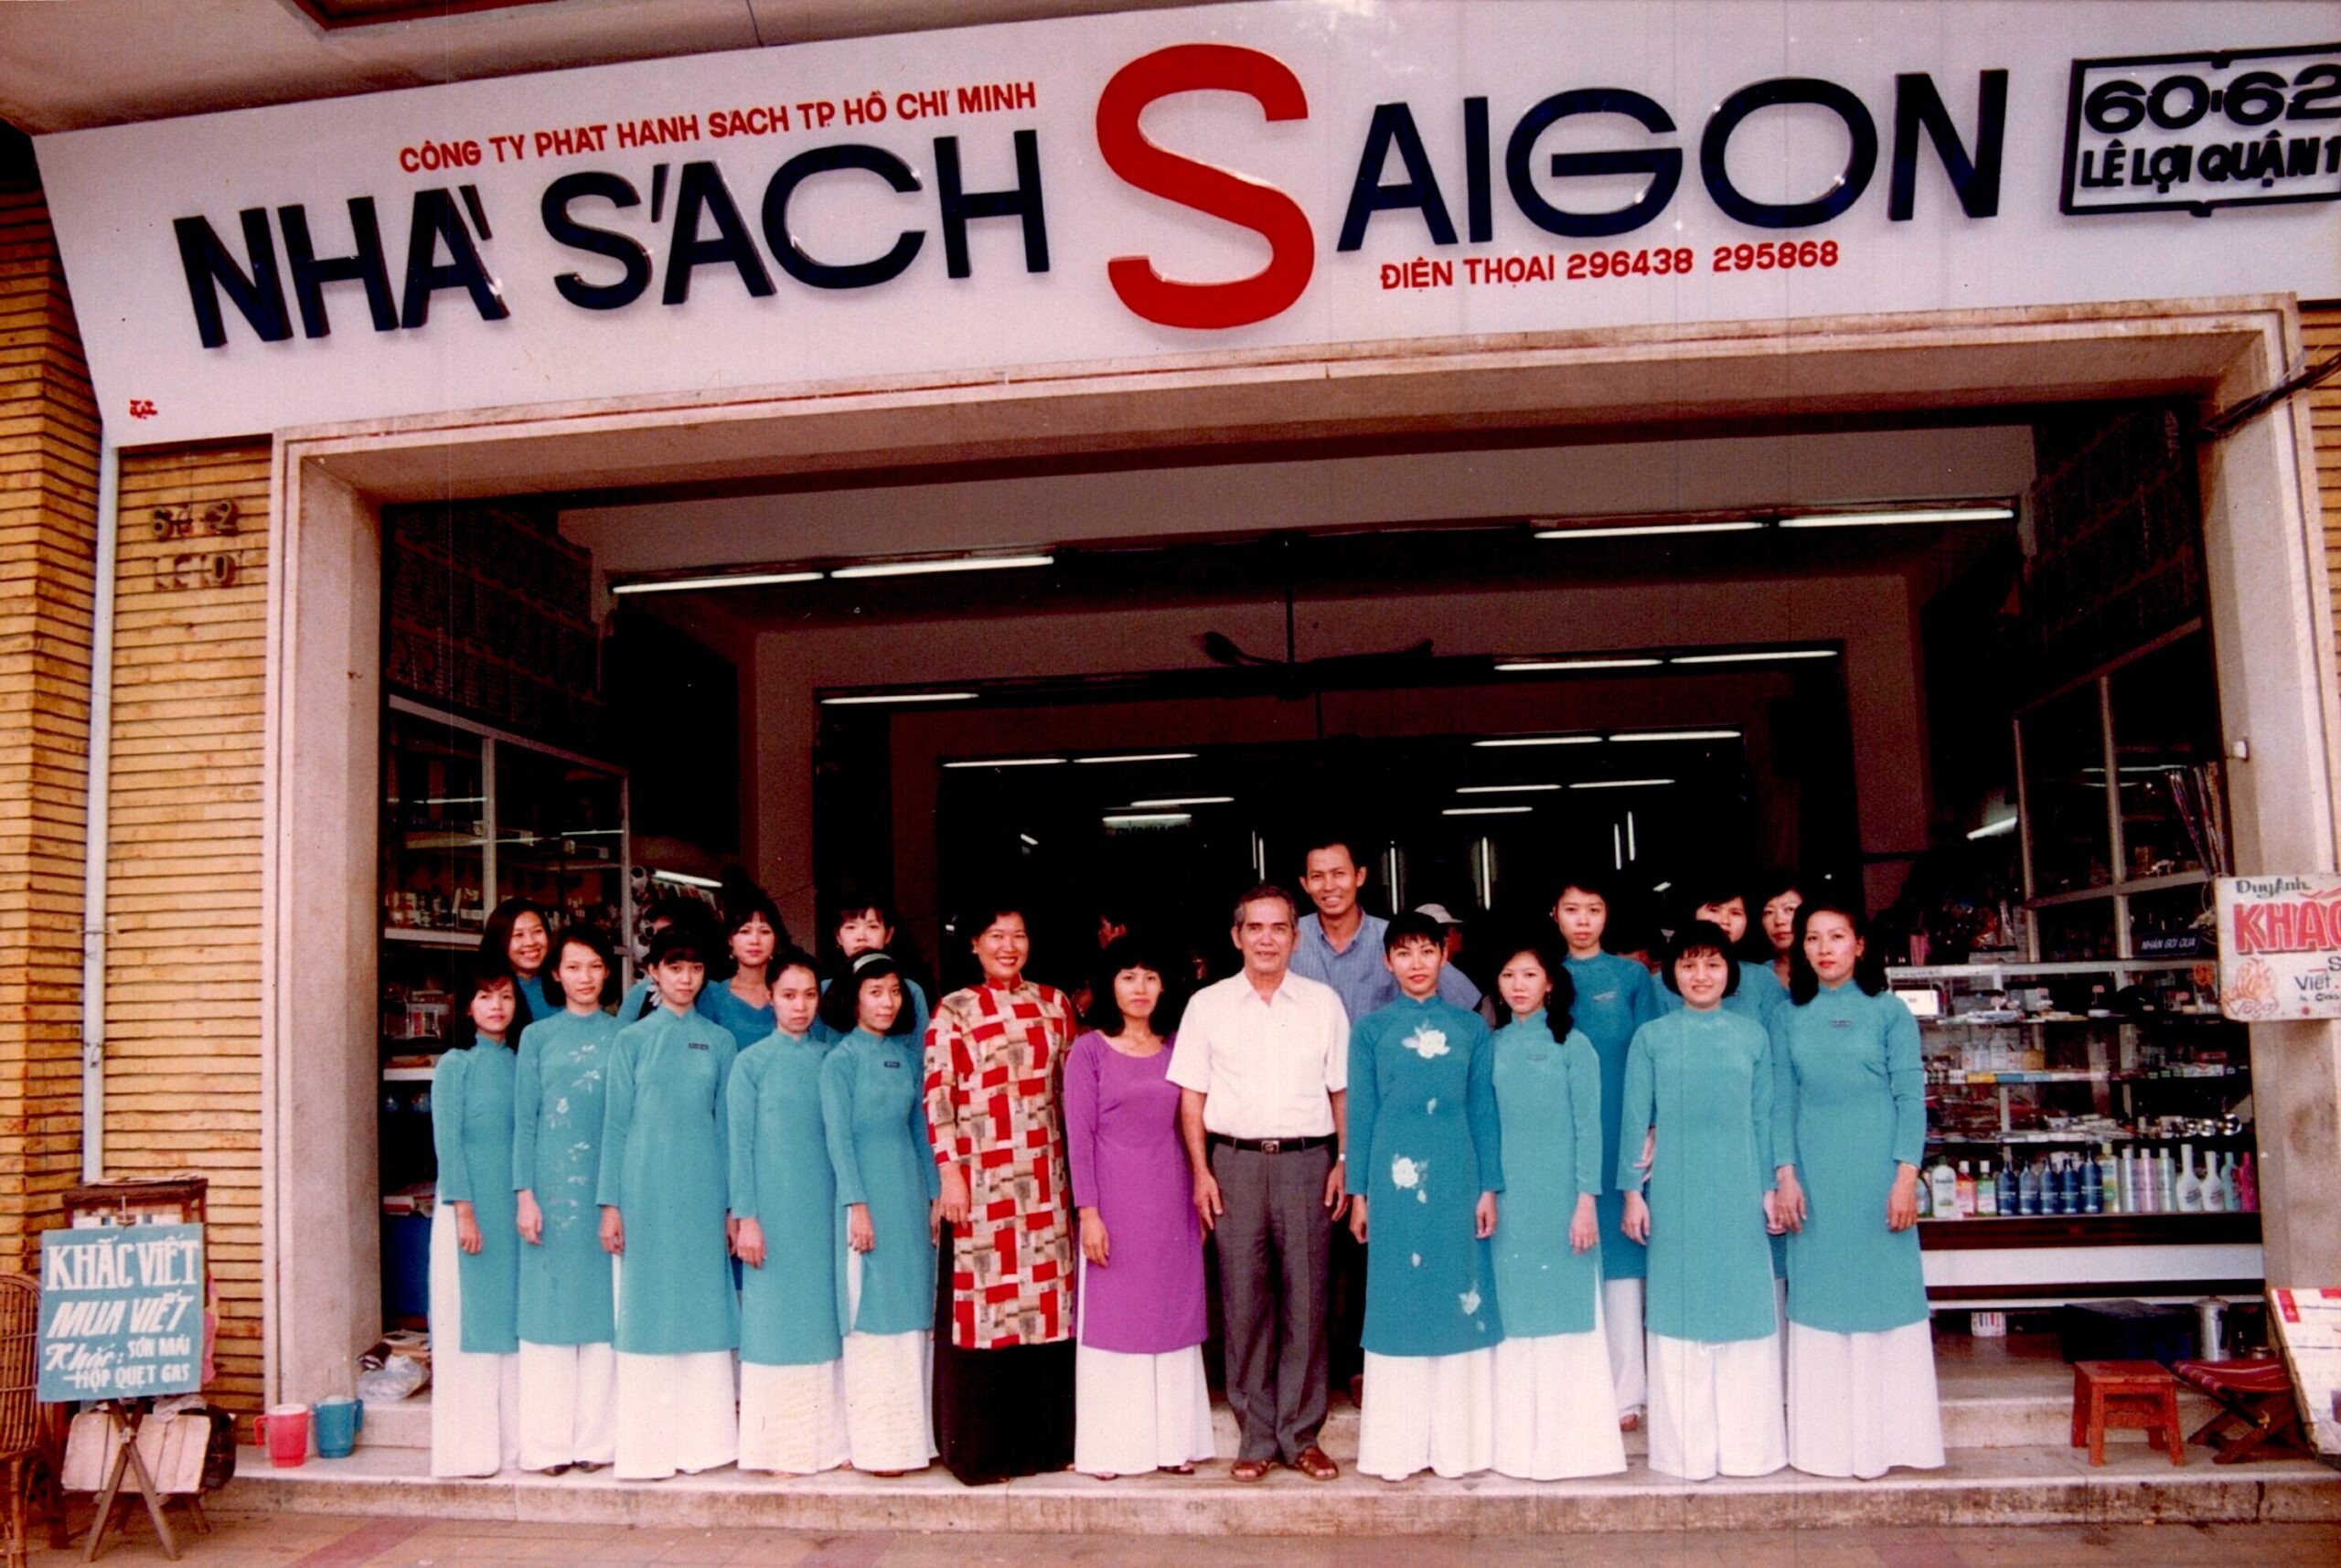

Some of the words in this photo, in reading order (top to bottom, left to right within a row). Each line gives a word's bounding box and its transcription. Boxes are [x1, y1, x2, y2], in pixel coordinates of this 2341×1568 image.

[399, 140, 481, 173] CÔNG
[489, 134, 525, 163] TY
[534, 125, 608, 158] PHÁT
[616, 114, 700, 148] HÀNH
[708, 105, 789, 138] SÁCH
[896, 90, 950, 121] CHÍ
[957, 81, 1037, 114] MINH
[2080, 139, 2126, 187] LÊ
[2197, 129, 2321, 187] QUẬN
[173, 184, 510, 348] NHÀ
[540, 129, 1050, 310] SÁCH
[1381, 256, 1453, 293] ĐIỆN
[1566, 248, 1694, 281] 296438
[1713, 240, 1839, 272] 295868
[46, 1235, 134, 1290] KHẮC
[135, 1232, 198, 1286] VIẾT
[46, 1300, 126, 1339] MUA
[130, 1289, 194, 1333] VIẾT
[161, 1363, 190, 1382] GAS
